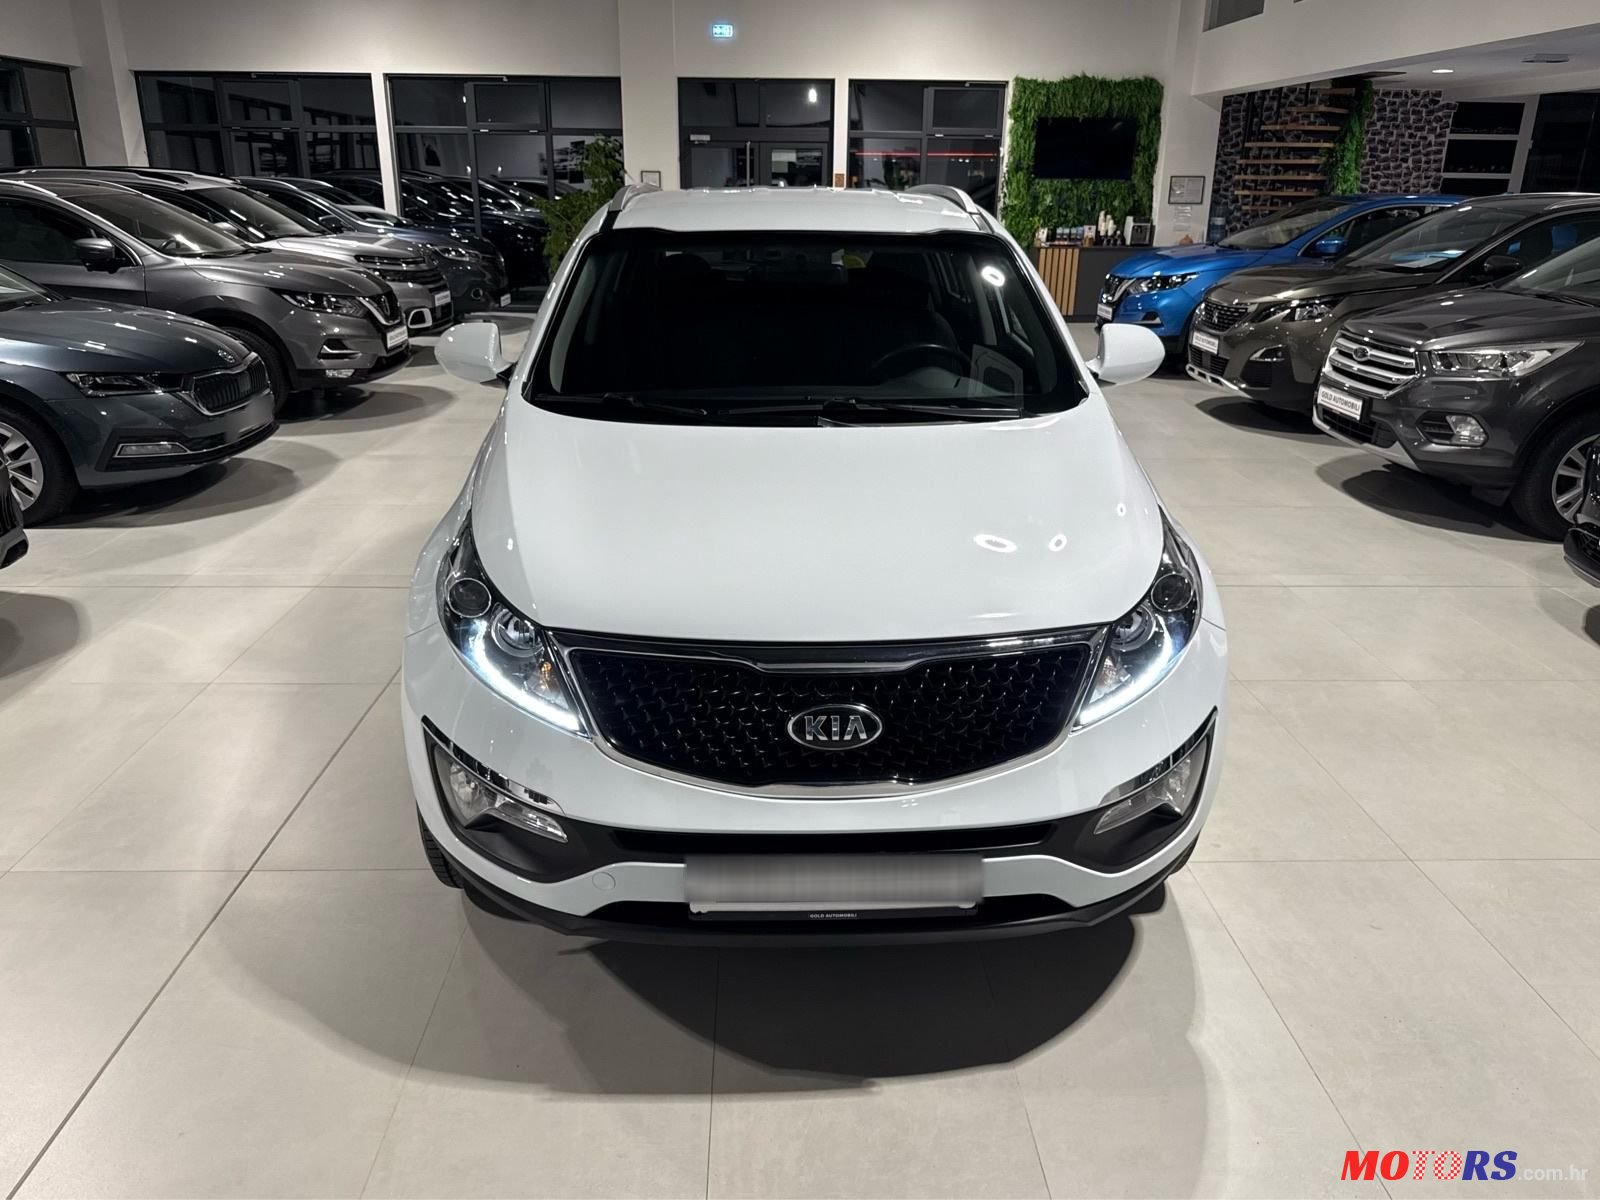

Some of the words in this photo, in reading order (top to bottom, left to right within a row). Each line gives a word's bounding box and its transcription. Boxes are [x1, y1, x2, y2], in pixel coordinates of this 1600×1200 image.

[1321, 390, 1333, 401] GOLD
[1332, 393, 1361, 412] AUTOMOBILI
[804, 715, 868, 741] KIA
